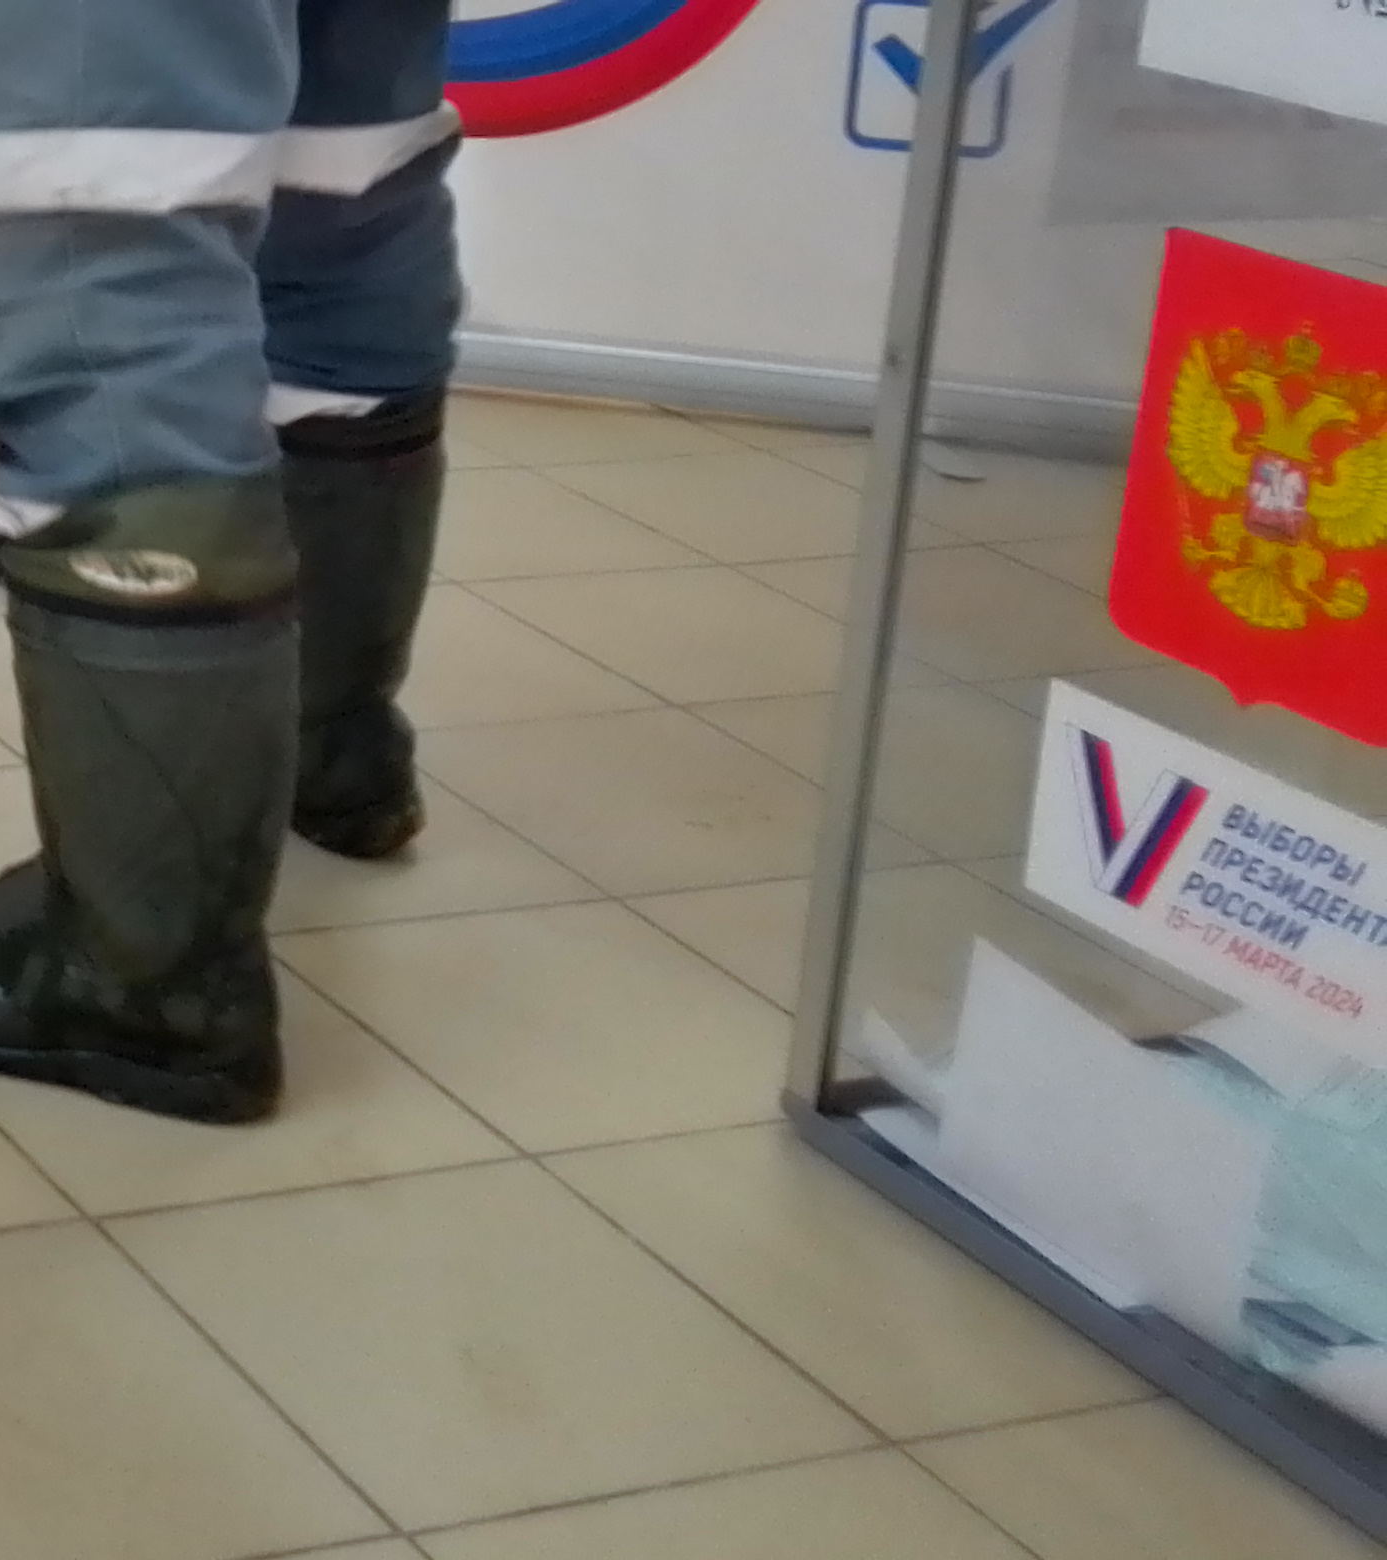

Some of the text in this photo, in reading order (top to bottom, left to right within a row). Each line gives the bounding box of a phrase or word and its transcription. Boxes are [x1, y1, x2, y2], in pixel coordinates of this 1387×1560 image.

[1221, 802, 1369, 887] ВЫБОРЫ
[1178, 869, 1311, 951] РОССИИ
[1198, 837, 1387, 948] ПРЕЗИДЕНТ
[1221, 935, 1306, 991] МАРТА
[1304, 973, 1365, 1018] 2024
